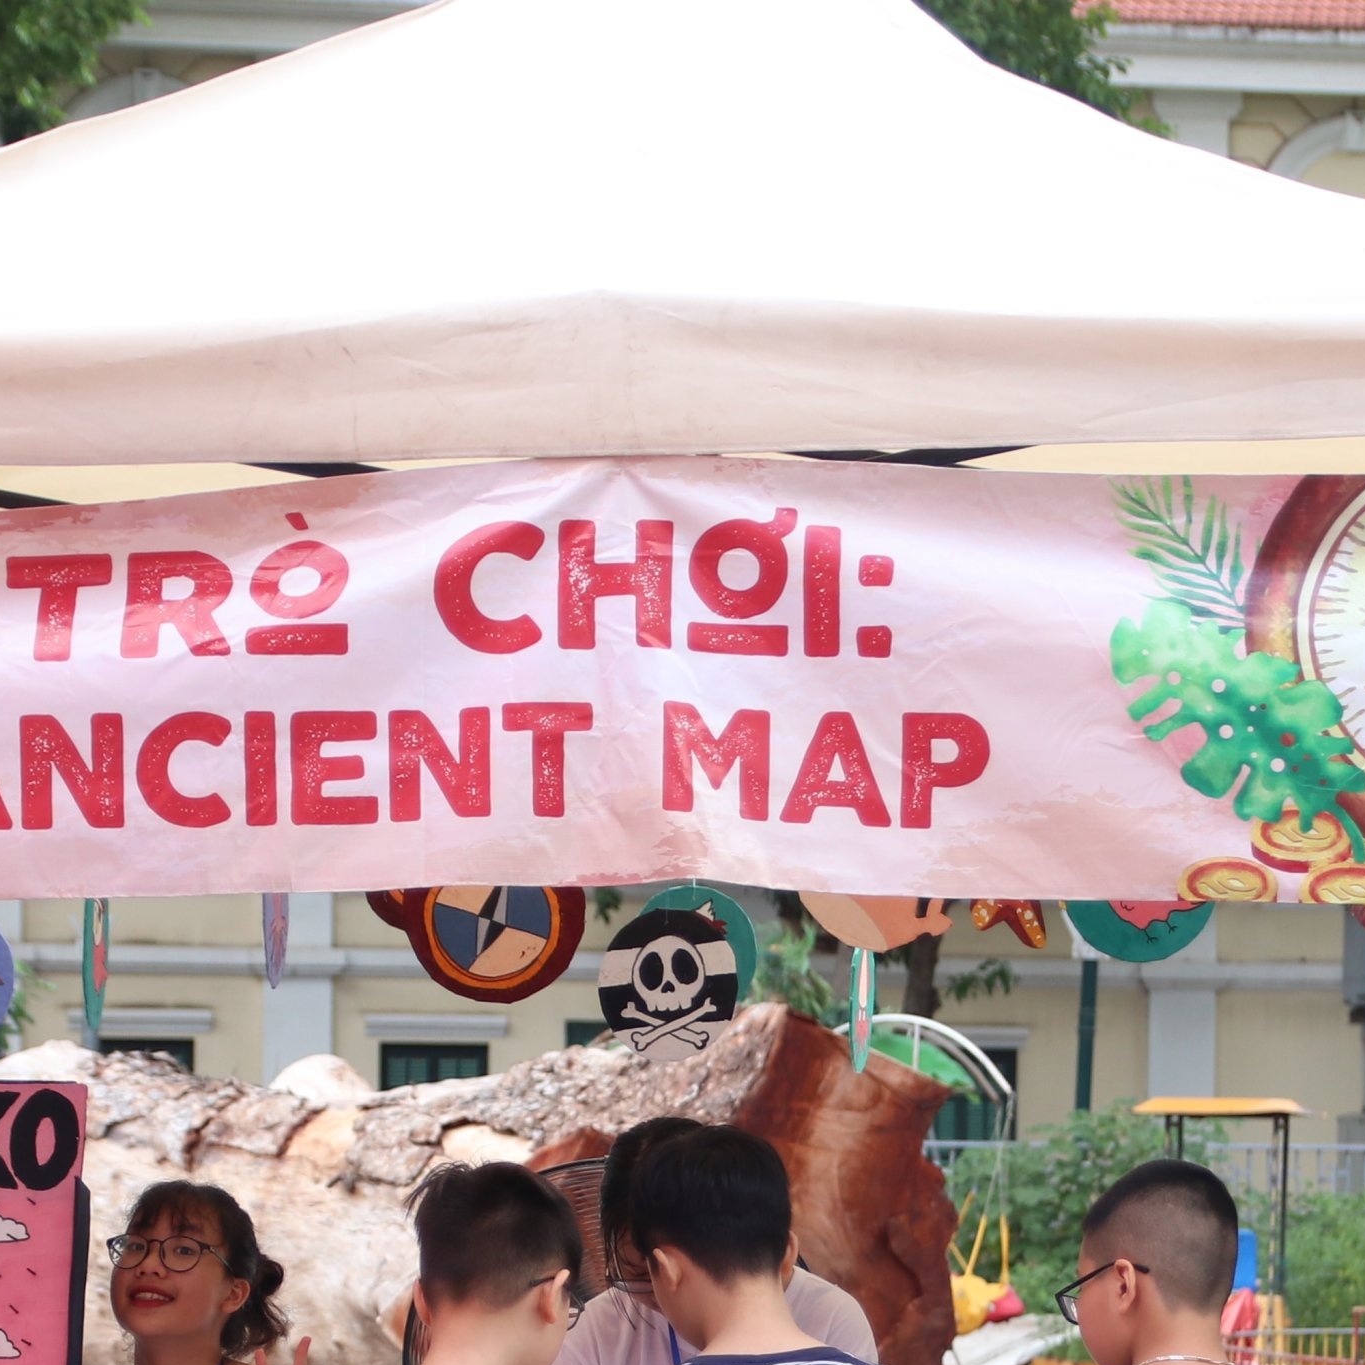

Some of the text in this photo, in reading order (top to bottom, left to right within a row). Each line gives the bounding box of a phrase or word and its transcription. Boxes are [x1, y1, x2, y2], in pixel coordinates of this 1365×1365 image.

[6, 512, 349, 661] TRÒ
[434, 507, 895, 658] CHƠI:
[662, 700, 991, 829] MAP
